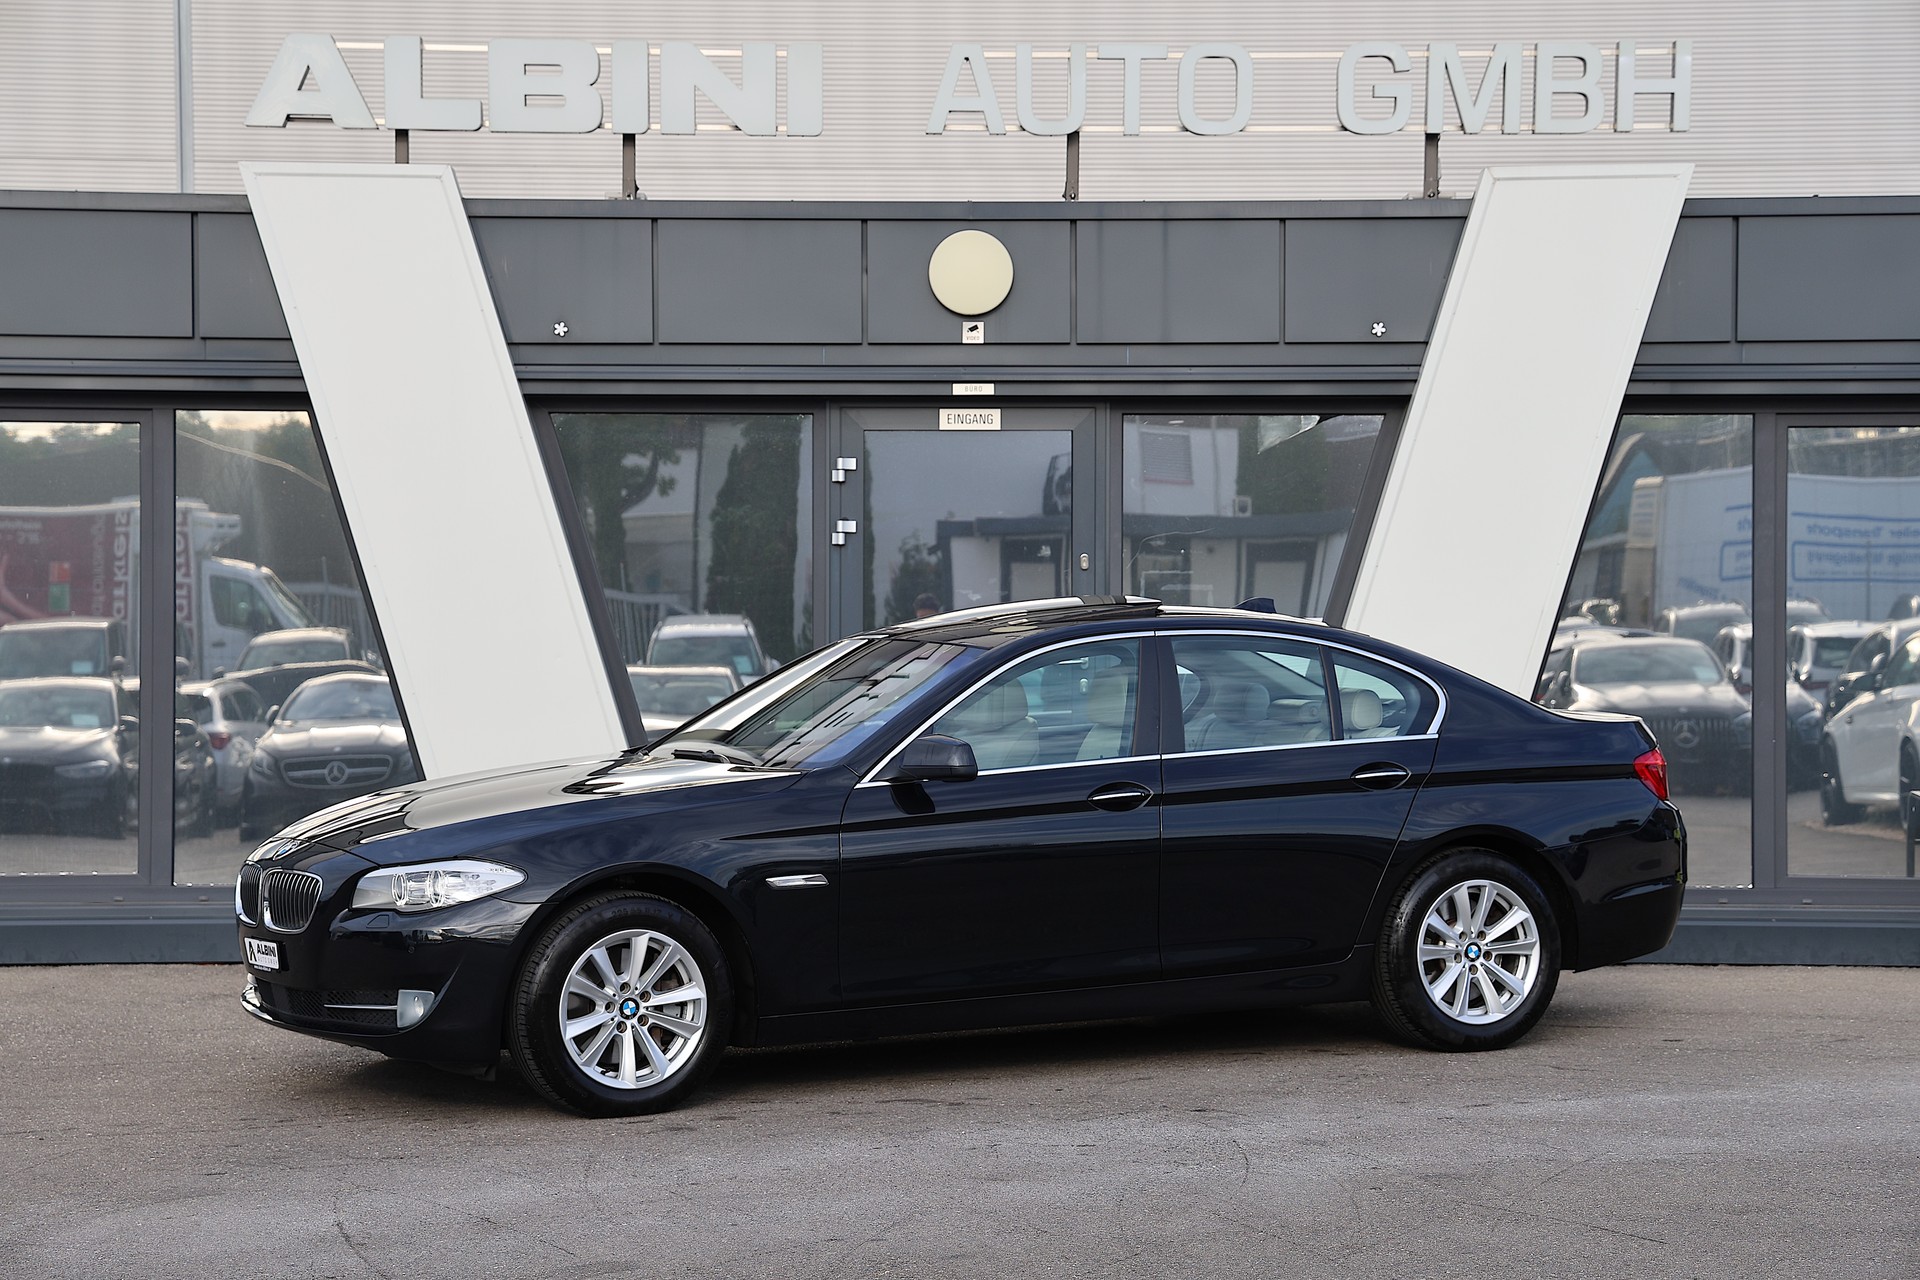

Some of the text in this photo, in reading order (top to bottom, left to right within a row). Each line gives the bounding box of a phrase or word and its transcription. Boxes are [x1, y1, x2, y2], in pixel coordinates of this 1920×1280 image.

[244, 33, 1693, 137] ALBINI AUTO GMBH
[947, 413, 994, 425] EINGANG
[257, 943, 277, 957] ALBINI
